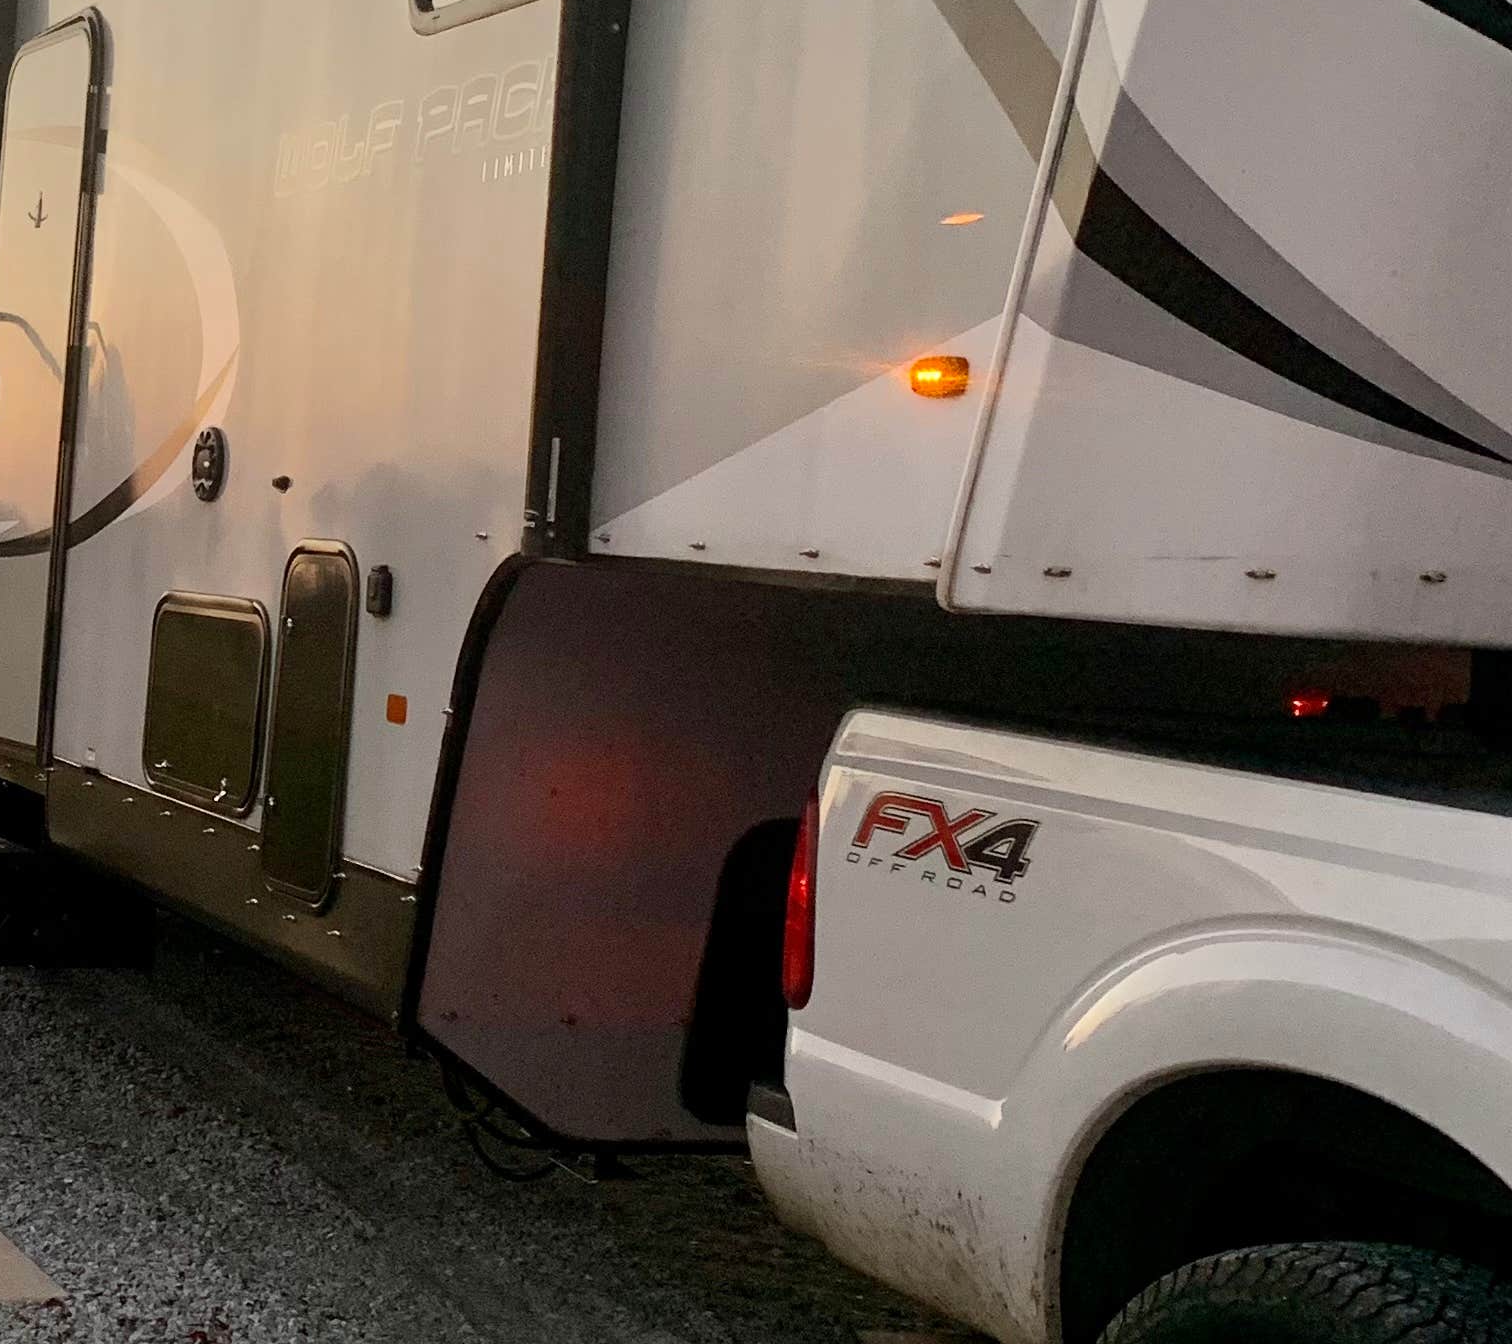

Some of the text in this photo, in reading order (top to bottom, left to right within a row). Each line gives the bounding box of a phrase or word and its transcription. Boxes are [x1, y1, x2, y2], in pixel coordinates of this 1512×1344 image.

[852, 790, 1041, 885] FX4
[846, 851, 1017, 903] OFF ROAD
